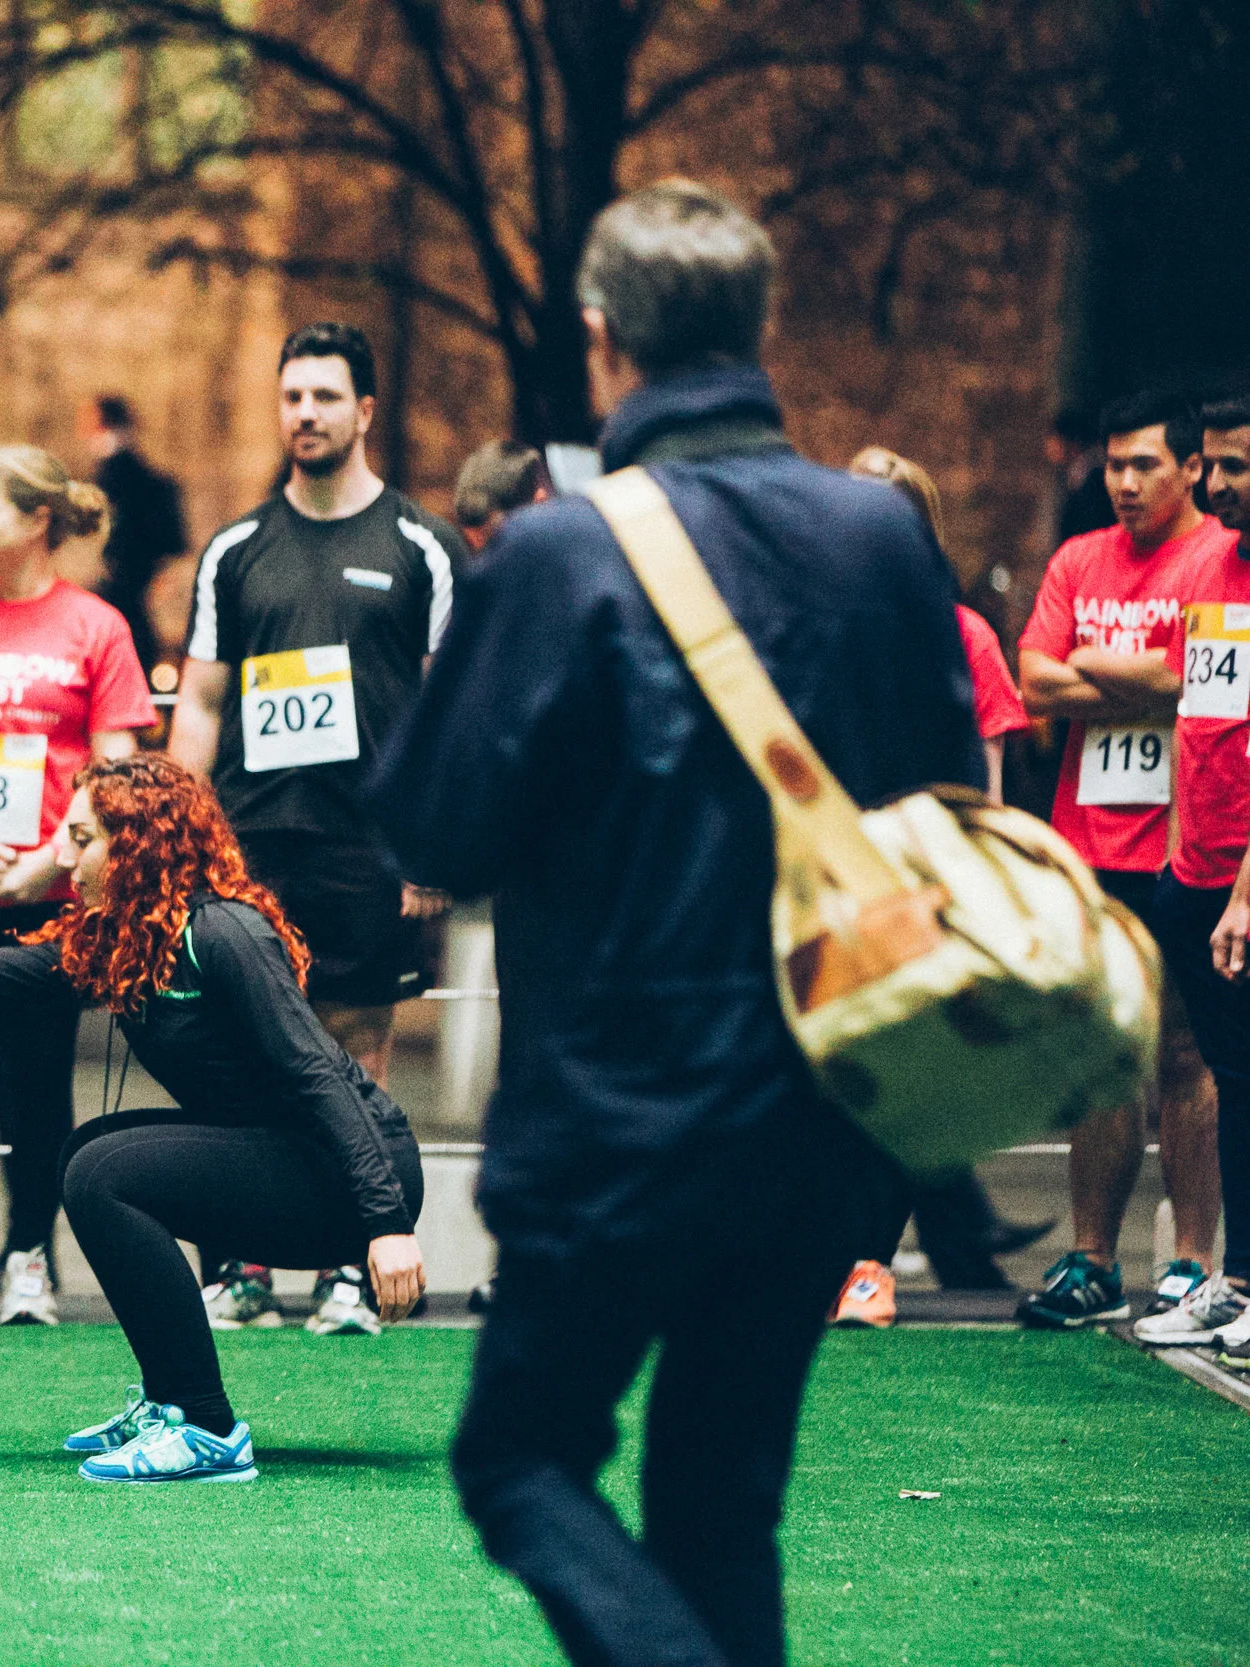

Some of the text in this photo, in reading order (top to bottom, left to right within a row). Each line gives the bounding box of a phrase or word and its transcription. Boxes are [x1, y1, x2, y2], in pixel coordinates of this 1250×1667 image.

[1187, 647, 1238, 685] 234
[257, 692, 336, 736] 202
[1097, 733, 1162, 772] 119
